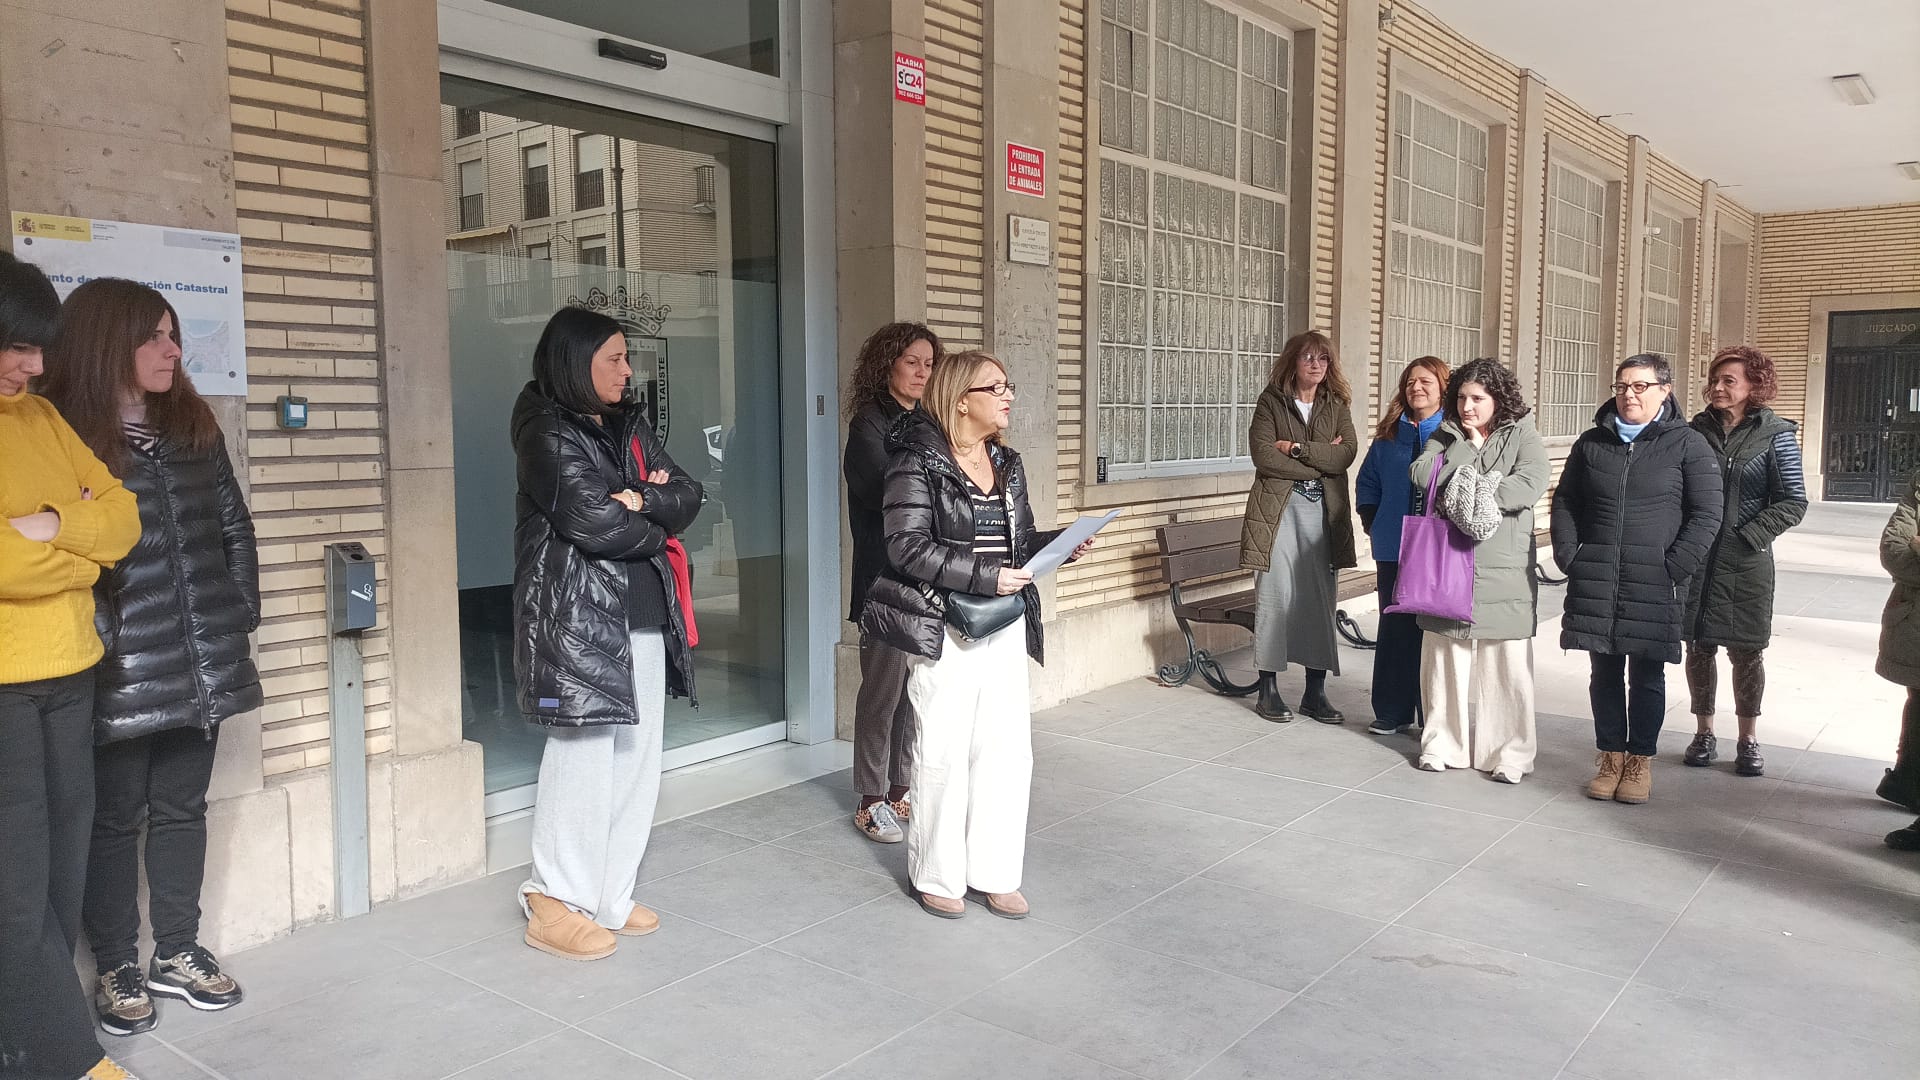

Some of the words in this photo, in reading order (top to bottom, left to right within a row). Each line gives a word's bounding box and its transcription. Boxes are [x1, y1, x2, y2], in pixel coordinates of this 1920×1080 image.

[896, 56, 923, 70] ALARMA
[1011, 149, 1040, 165] PROHIBIDA
[1010, 162, 1018, 173] LA
[1018, 163, 1041, 178] ENTRADA
[1008, 175, 1017, 186] DE
[1017, 177, 1043, 191] ANIMALES
[175, 282, 228, 294] Catastral
[658, 357, 666, 403] TAUSTE
[659, 405, 666, 420] DE
